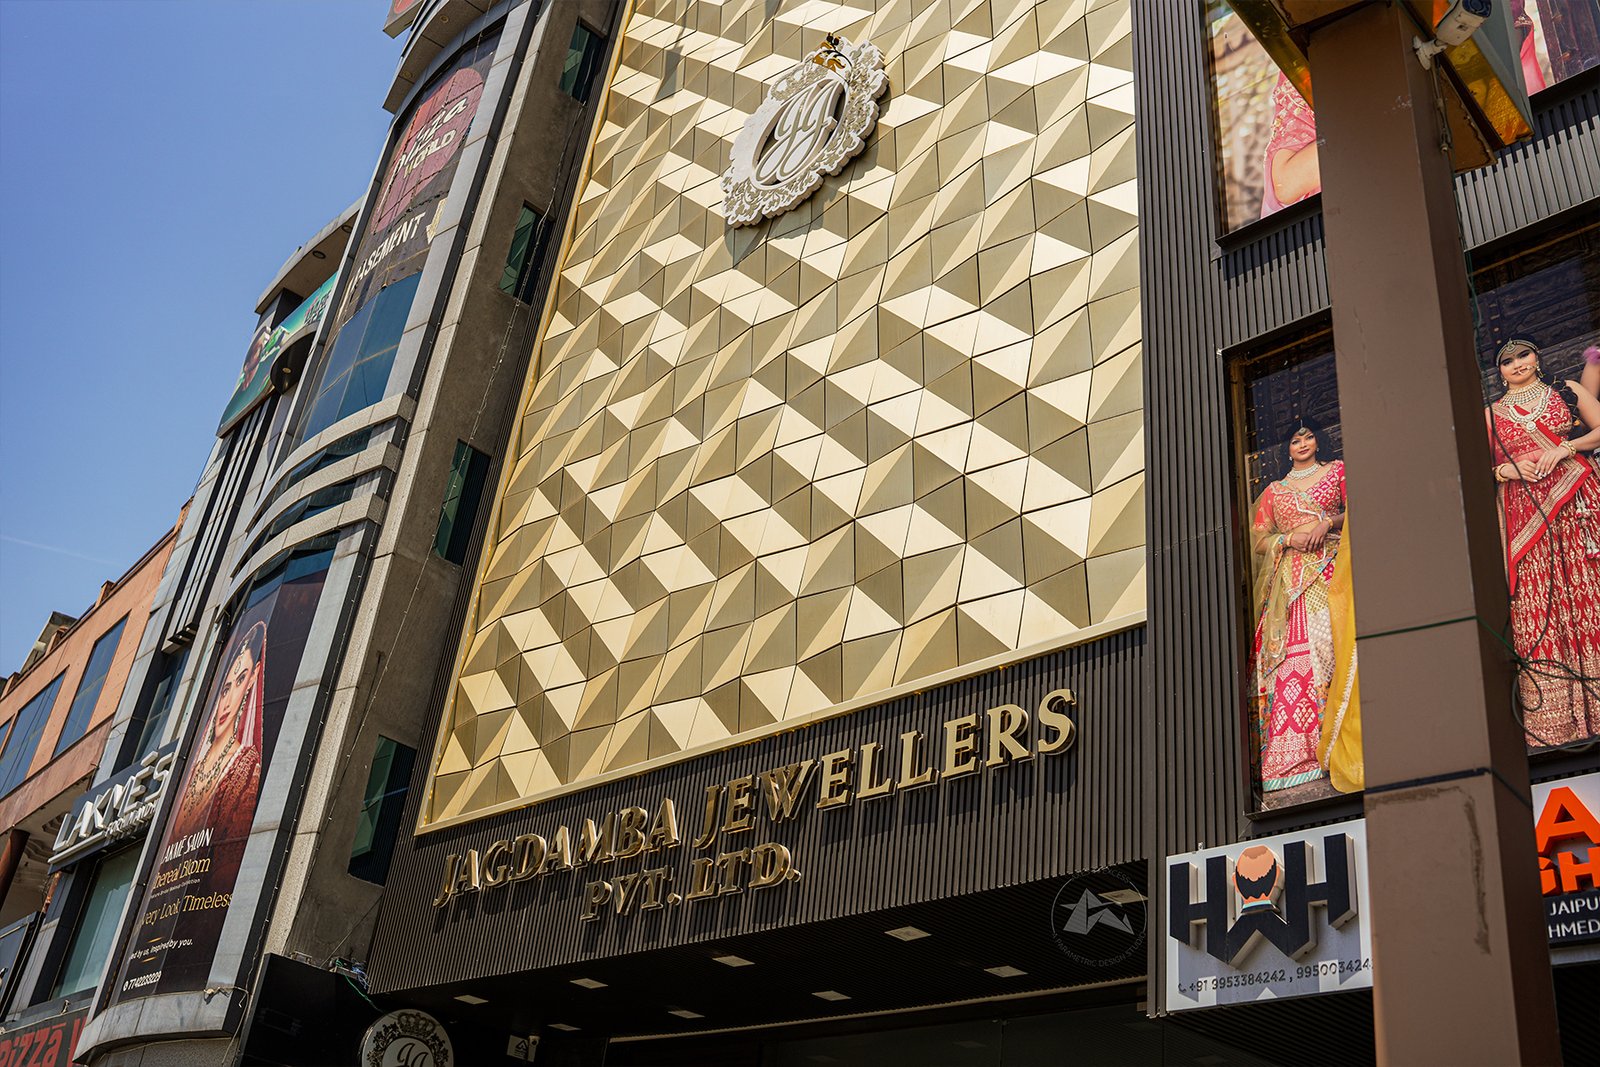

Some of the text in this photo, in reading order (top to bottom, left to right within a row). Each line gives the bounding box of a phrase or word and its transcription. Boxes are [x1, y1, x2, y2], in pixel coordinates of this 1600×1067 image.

[433, 688, 1078, 908] JAGDAMBA JEWELLERS
[686, 842, 802, 902] LTD.
[160, 898, 181, 920] Look
[1550, 896, 1600, 916] JAIPU
[1548, 919, 1600, 938] HMED
[1296, 958, 1373, 980] 995003424
